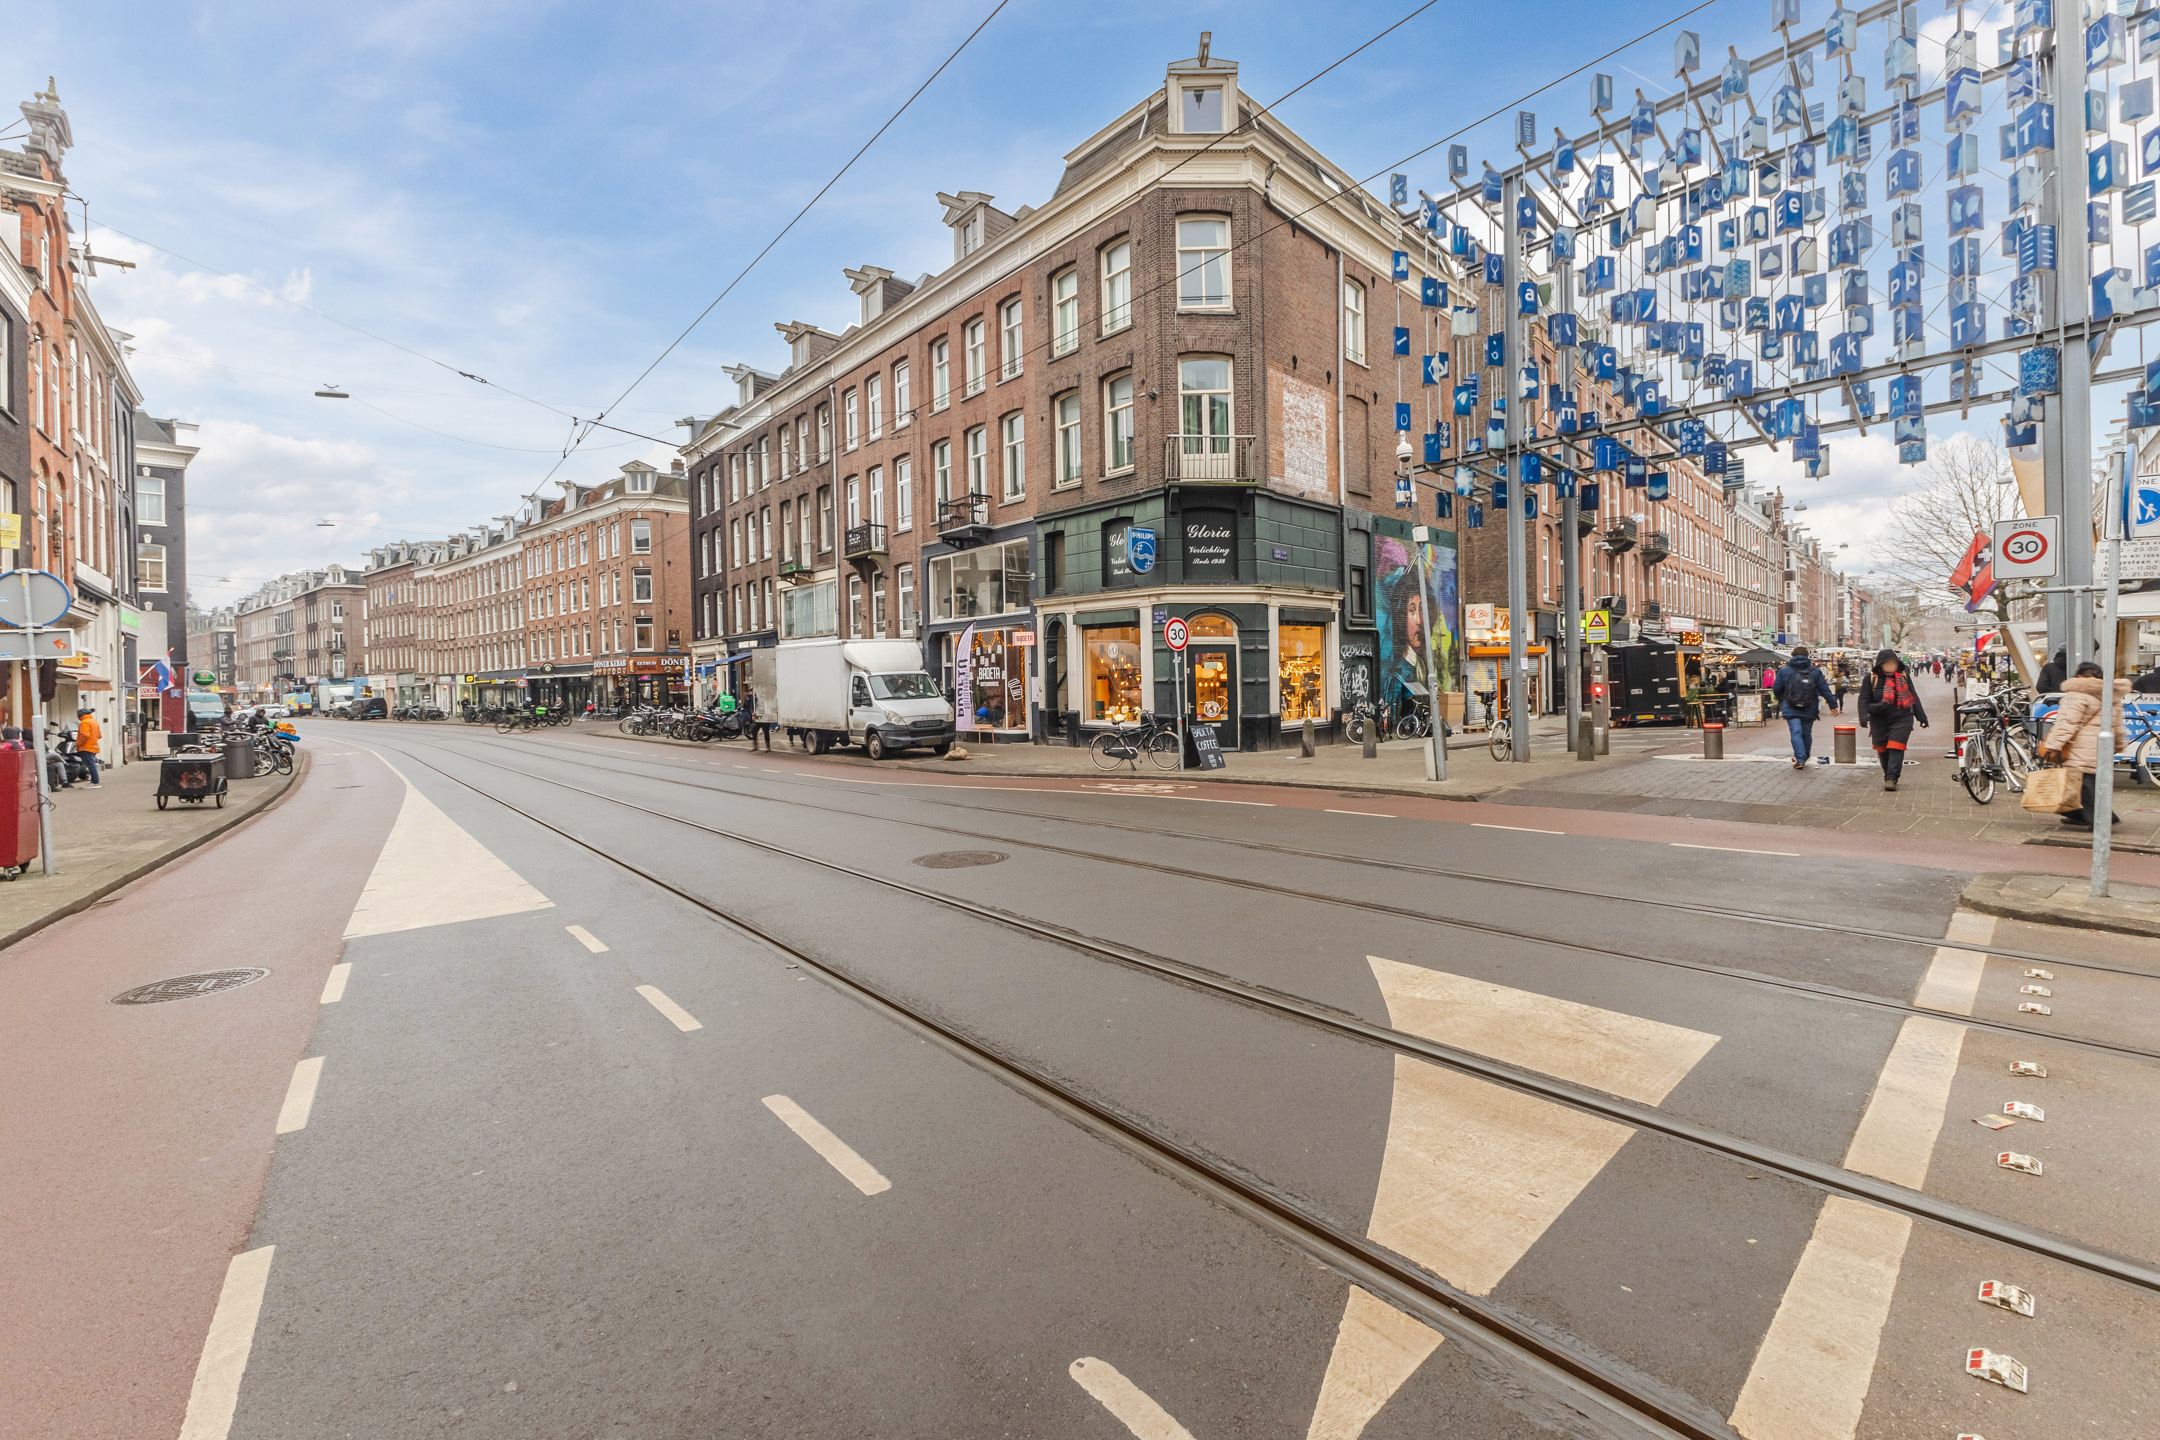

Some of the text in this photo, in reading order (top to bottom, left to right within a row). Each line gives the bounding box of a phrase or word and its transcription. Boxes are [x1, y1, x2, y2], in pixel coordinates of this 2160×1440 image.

[2020, 107, 2049, 146] T t
[1888, 157, 1915, 191] R r
[1776, 197, 1800, 229] E e
[1678, 228, 1700, 261] B b
[1890, 269, 1918, 302] P p
[1524, 287, 1535, 302] a
[1776, 307, 1785, 330] Y
[1789, 301, 1801, 323] y
[1952, 306, 1981, 342] T t
[1679, 328, 1700, 355] U u
[1602, 352, 1613, 367] c
[1831, 335, 1857, 369] K k
[1726, 366, 1748, 394] R r
[1636, 387, 1656, 412] A a
[1561, 406, 1577, 421] m
[1187, 524, 1231, 538] Gloria
[2012, 522, 2038, 530] ZONE
[1109, 533, 1125, 547] Glo
[1132, 531, 1155, 540] PHILIPS
[1188, 545, 1230, 557] Verlichting
[2011, 540, 2039, 554] 30
[1170, 628, 1186, 641] 30
[978, 666, 1001, 680] BADETA
[1191, 727, 1216, 738] BADETA
[1196, 739, 1219, 751] COFFEE
